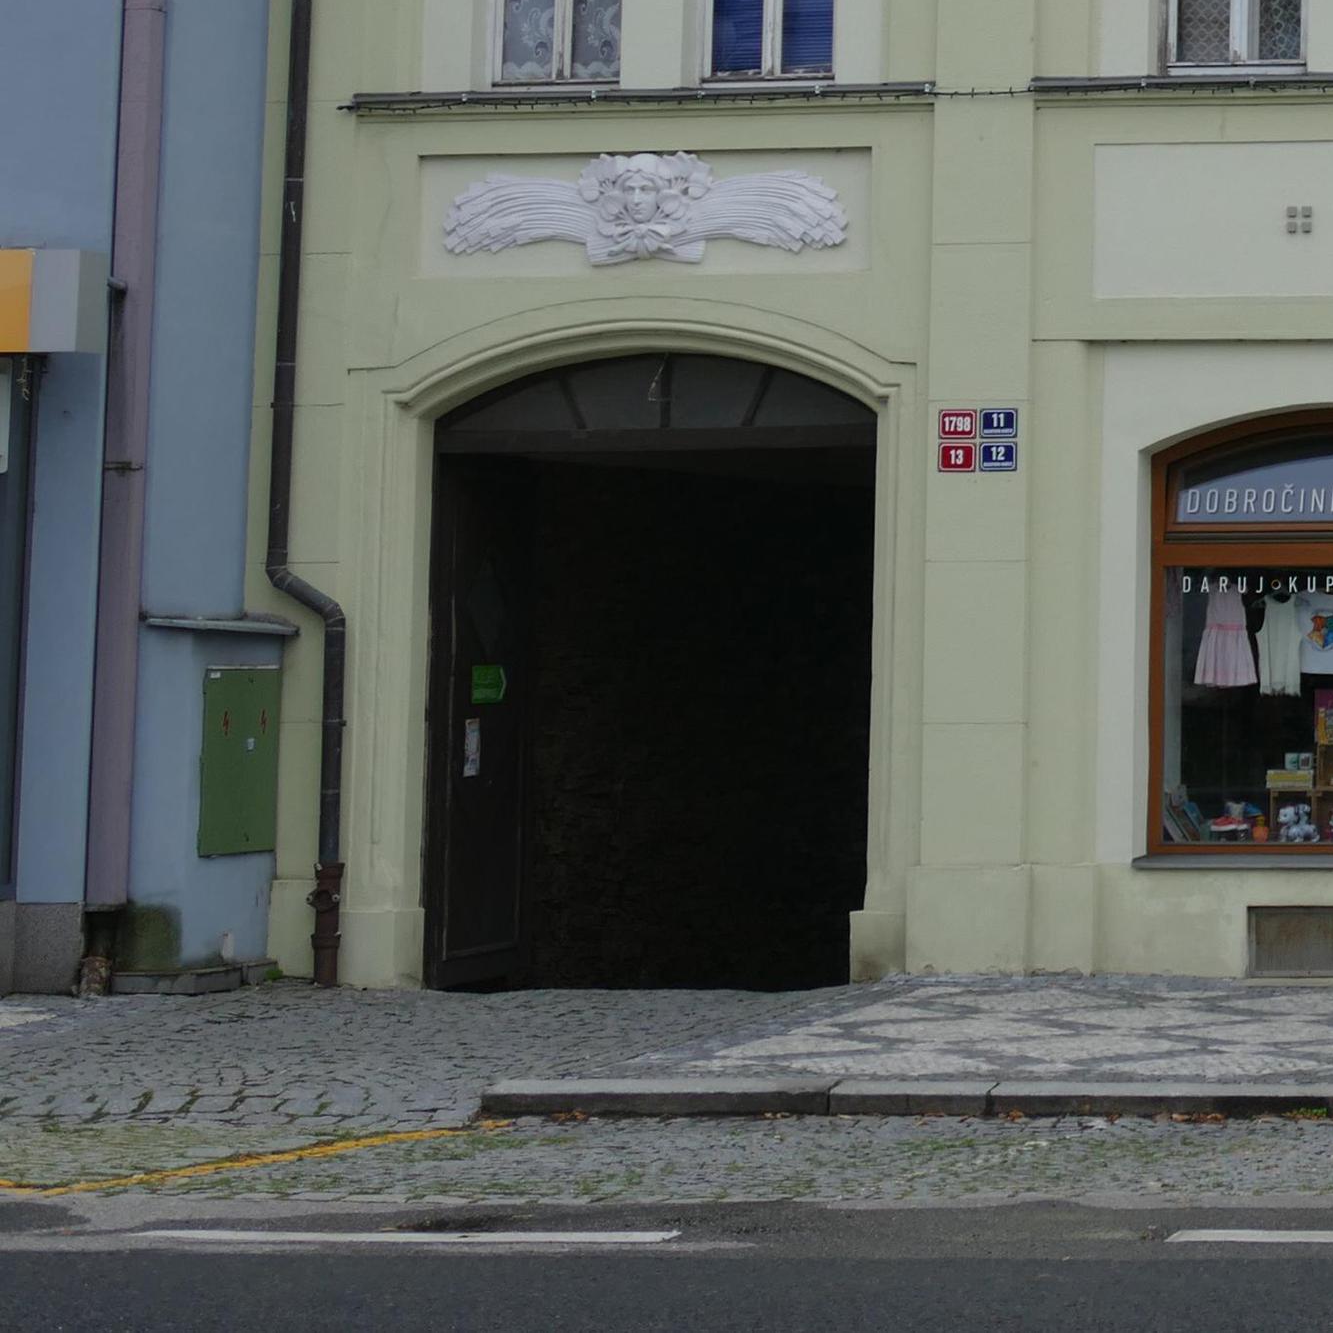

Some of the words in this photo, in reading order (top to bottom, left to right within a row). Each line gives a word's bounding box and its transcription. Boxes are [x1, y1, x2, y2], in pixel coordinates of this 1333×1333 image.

[943, 416, 971, 432] 1798
[991, 413, 1005, 428] 11
[949, 449, 964, 465] 13
[990, 446, 1006, 461] 12
[1182, 576, 1264, 594] DARUJ
